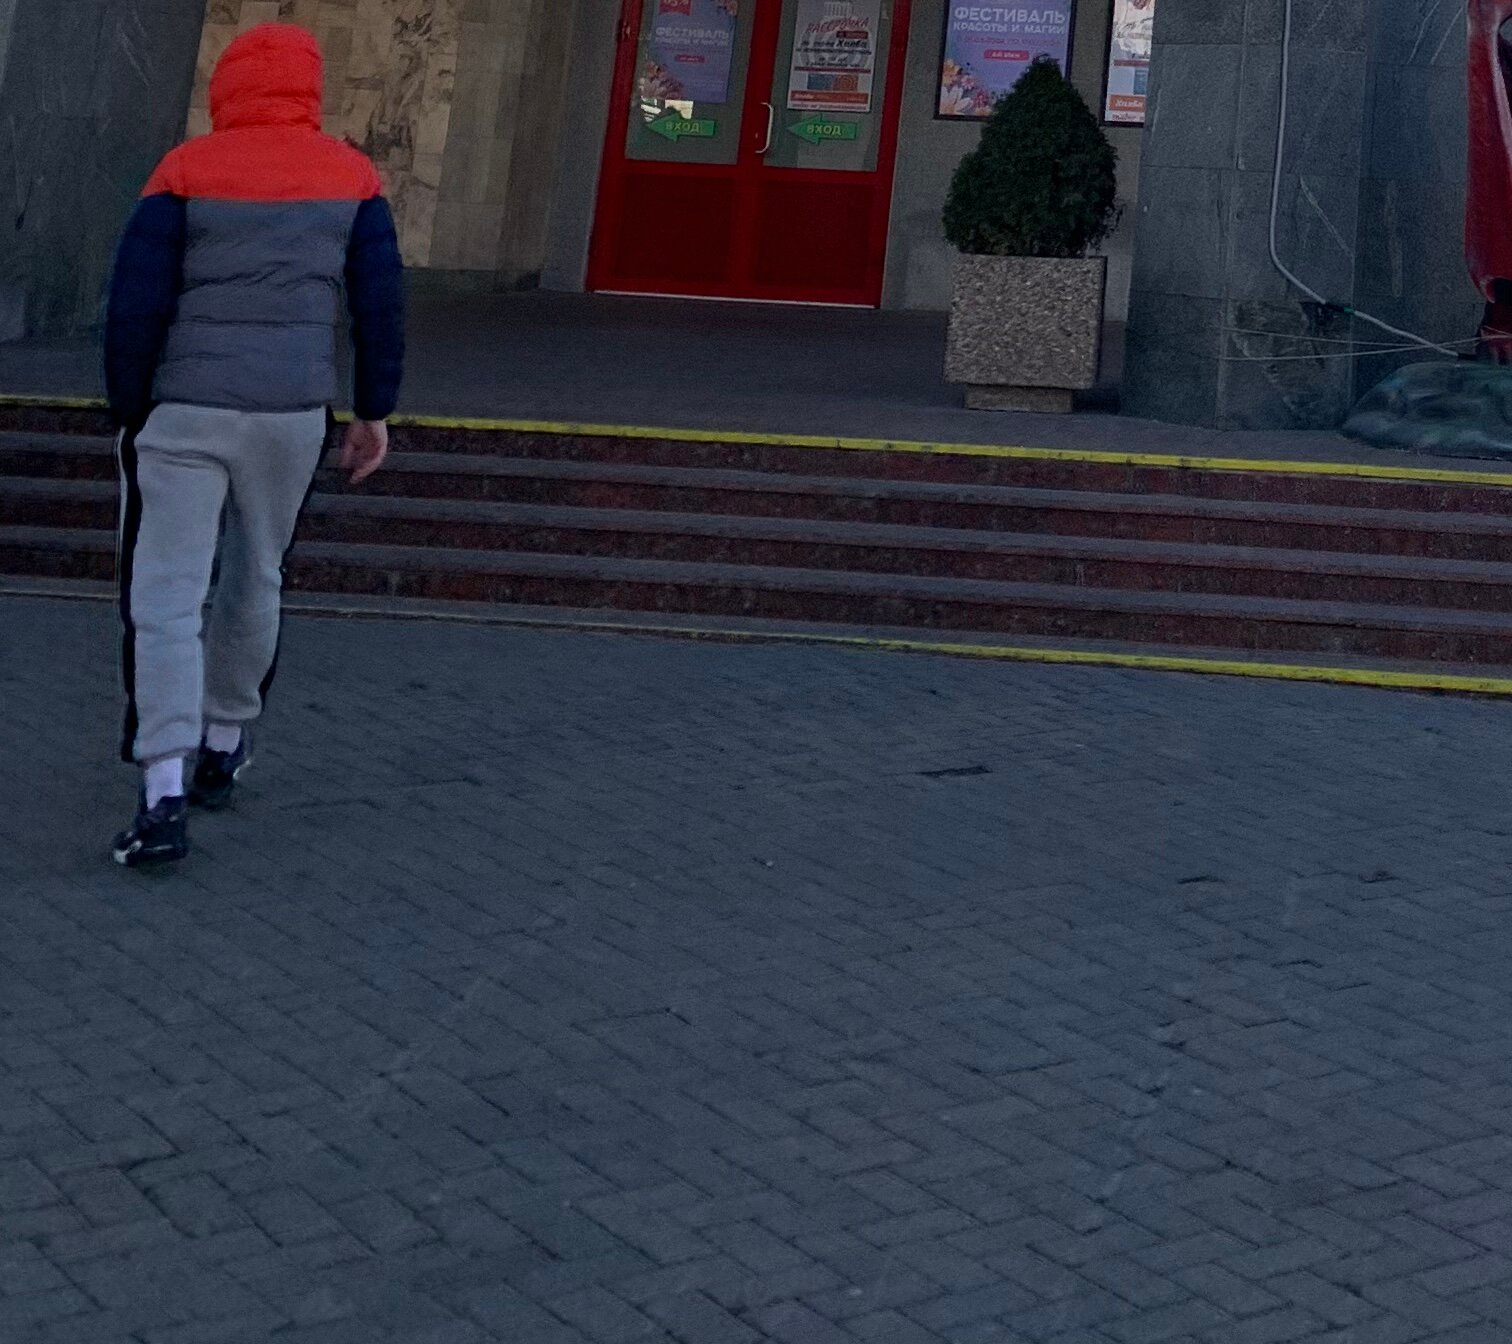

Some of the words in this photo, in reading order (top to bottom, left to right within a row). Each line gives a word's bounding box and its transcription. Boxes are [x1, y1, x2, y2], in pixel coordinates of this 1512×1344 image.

[954, 6, 1066, 25] ФЕСТИВАЛЬ
[655, 26, 730, 40] ФЕСТИВАЛЬ
[953, 21, 1008, 33] КРАСОТЫ
[1011, 24, 1019, 33] И
[1023, 24, 1065, 35] МАГИИ
[666, 121, 700, 133] ВХОД
[806, 124, 842, 136] ВХОД
